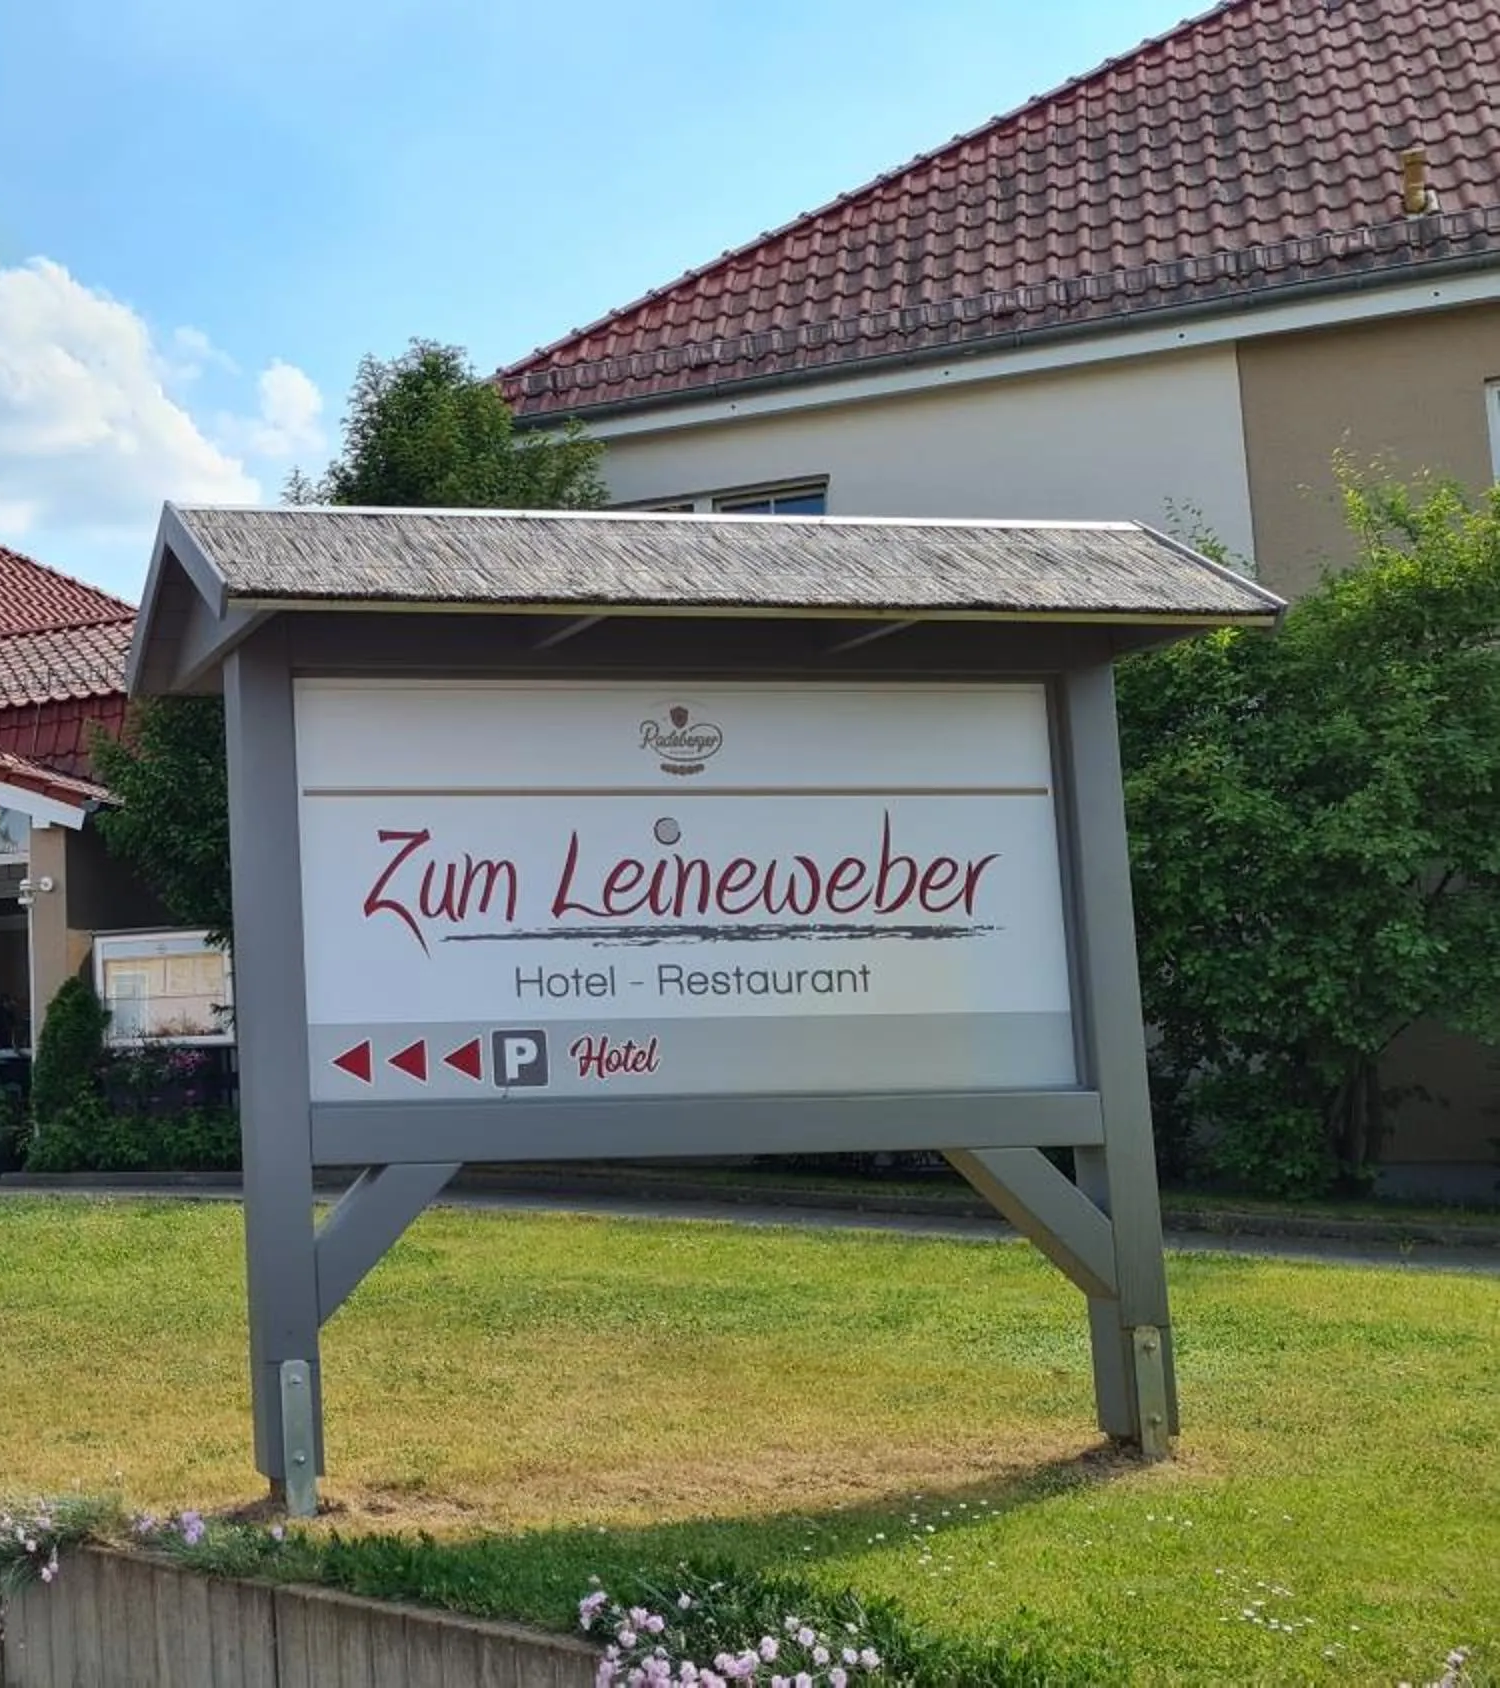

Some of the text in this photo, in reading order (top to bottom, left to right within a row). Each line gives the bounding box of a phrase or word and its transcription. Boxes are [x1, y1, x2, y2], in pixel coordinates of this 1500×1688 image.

[639, 719, 723, 761] Radeberger
[364, 810, 1004, 959] Zum Leineweber
[515, 965, 616, 998] Hotel
[657, 963, 871, 996] Restaurant
[503, 1035, 660, 1079] P Hotel
